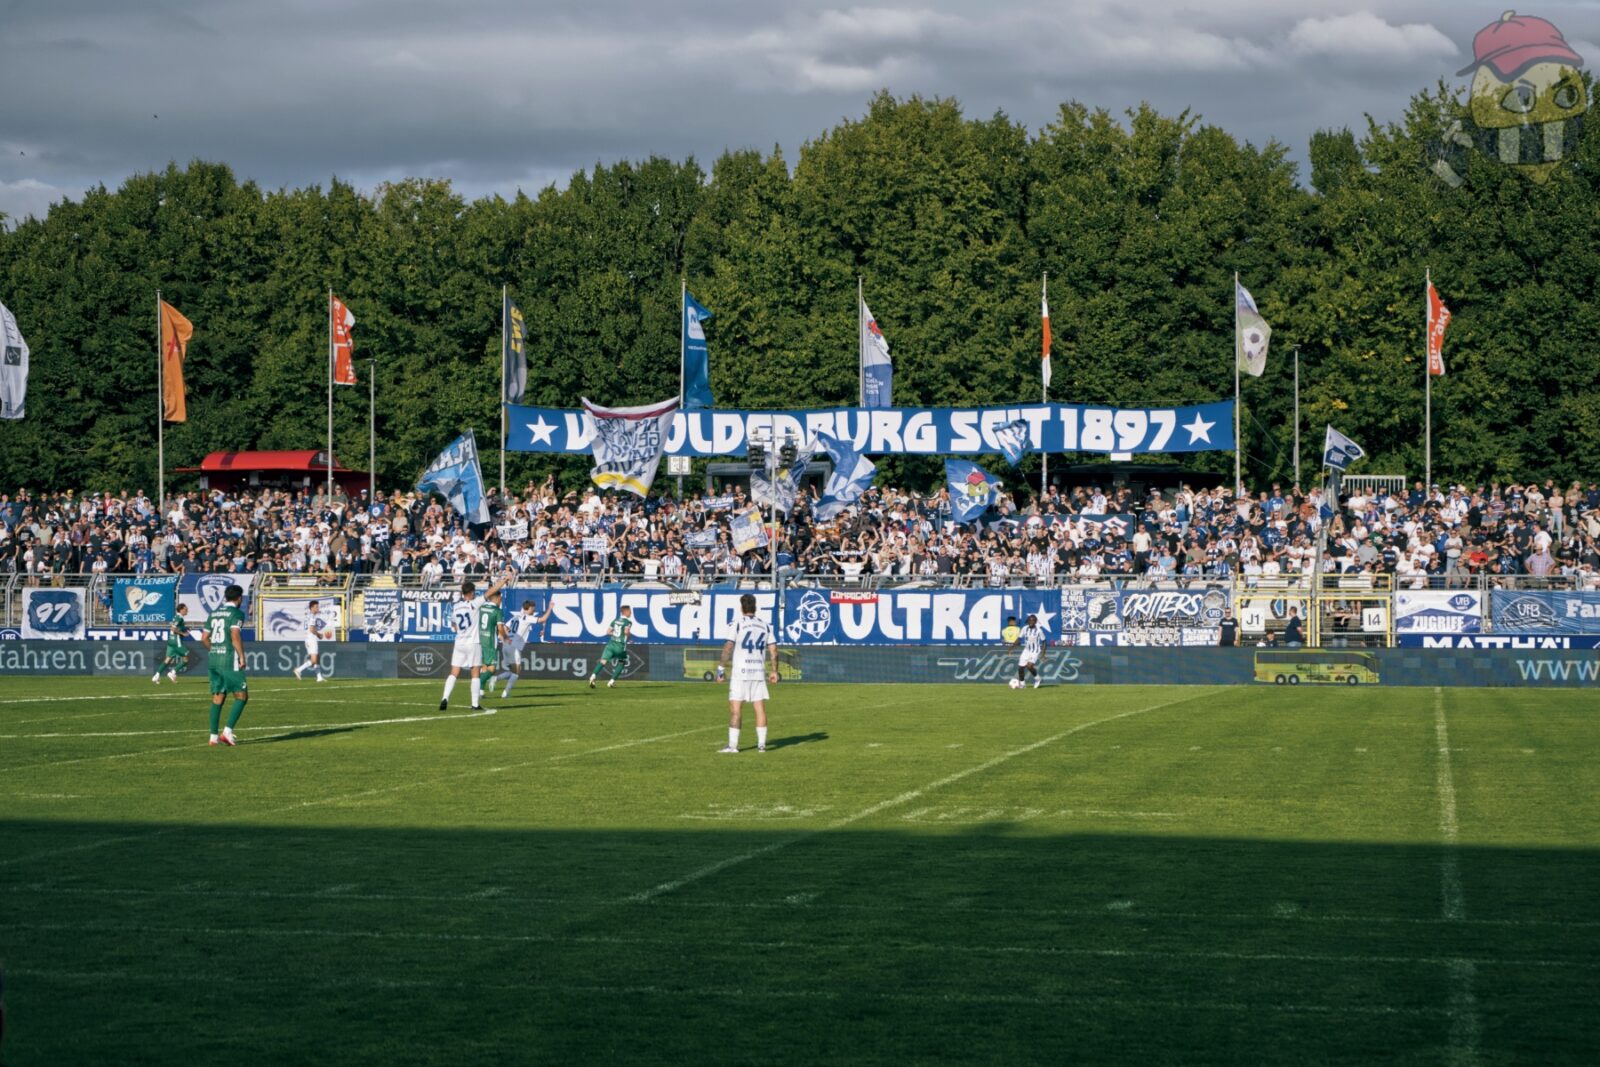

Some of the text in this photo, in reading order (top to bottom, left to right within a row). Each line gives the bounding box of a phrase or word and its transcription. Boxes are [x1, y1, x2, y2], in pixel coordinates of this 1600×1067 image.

[1060, 408, 1176, 450] 1897
[401, 591, 451, 600] MARLON
[36, 602, 71, 624] 97
[1122, 592, 1203, 621] CRITTERS
[1517, 603, 1541, 618] VfB
[118, 614, 128, 622] DE
[456, 612, 472, 631] 21
[481, 613, 489, 630] 9
[1089, 623, 1121, 631] UNITE
[1246, 613, 1260, 625] J1
[1412, 615, 1464, 633] ZUGRIFF
[210, 618, 226, 644] 23
[741, 630, 766, 655] 44
[95, 645, 147, 670] den
[414, 652, 433, 665] VfB
